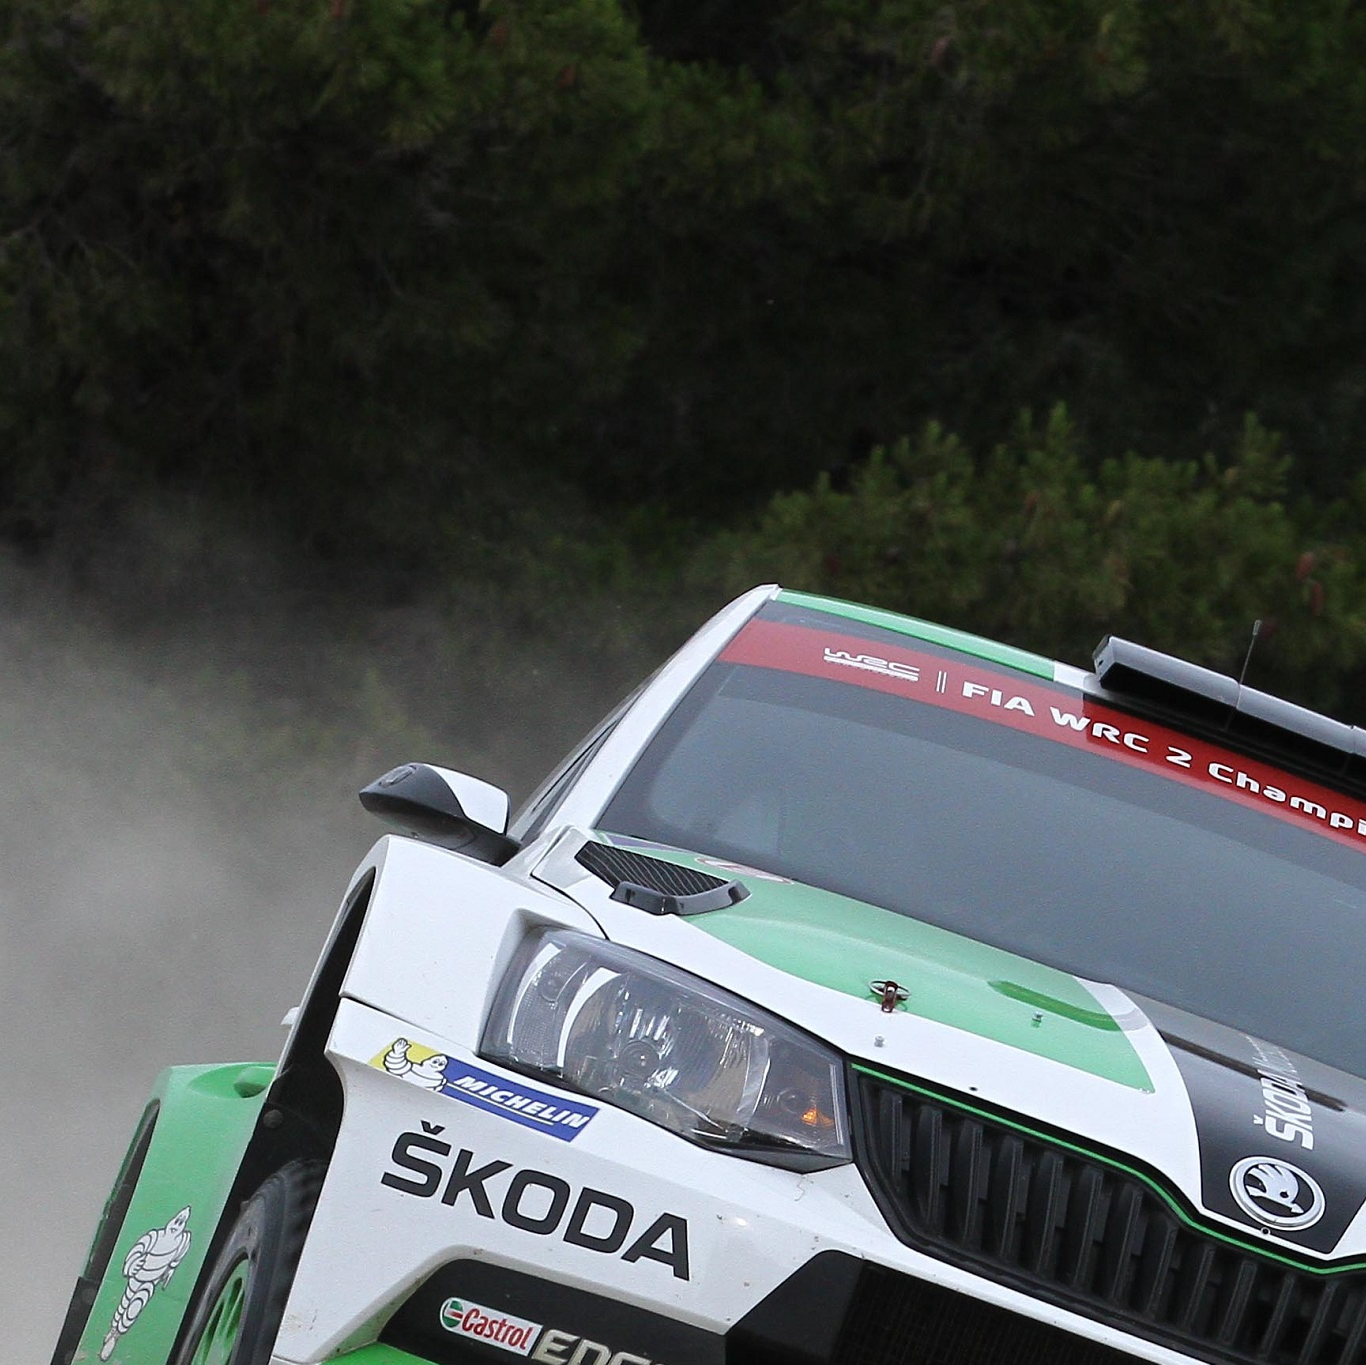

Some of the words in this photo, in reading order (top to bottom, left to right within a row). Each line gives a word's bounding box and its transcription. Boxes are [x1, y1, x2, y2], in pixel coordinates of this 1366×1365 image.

[962, 681, 1035, 717] FIA
[1050, 706, 1149, 754] WRC
[1165, 746, 1193, 769] 2
[454, 1074, 590, 1130] MICHELIN
[380, 1120, 690, 1282] ŠKODA
[461, 1307, 533, 1351] Castrol
